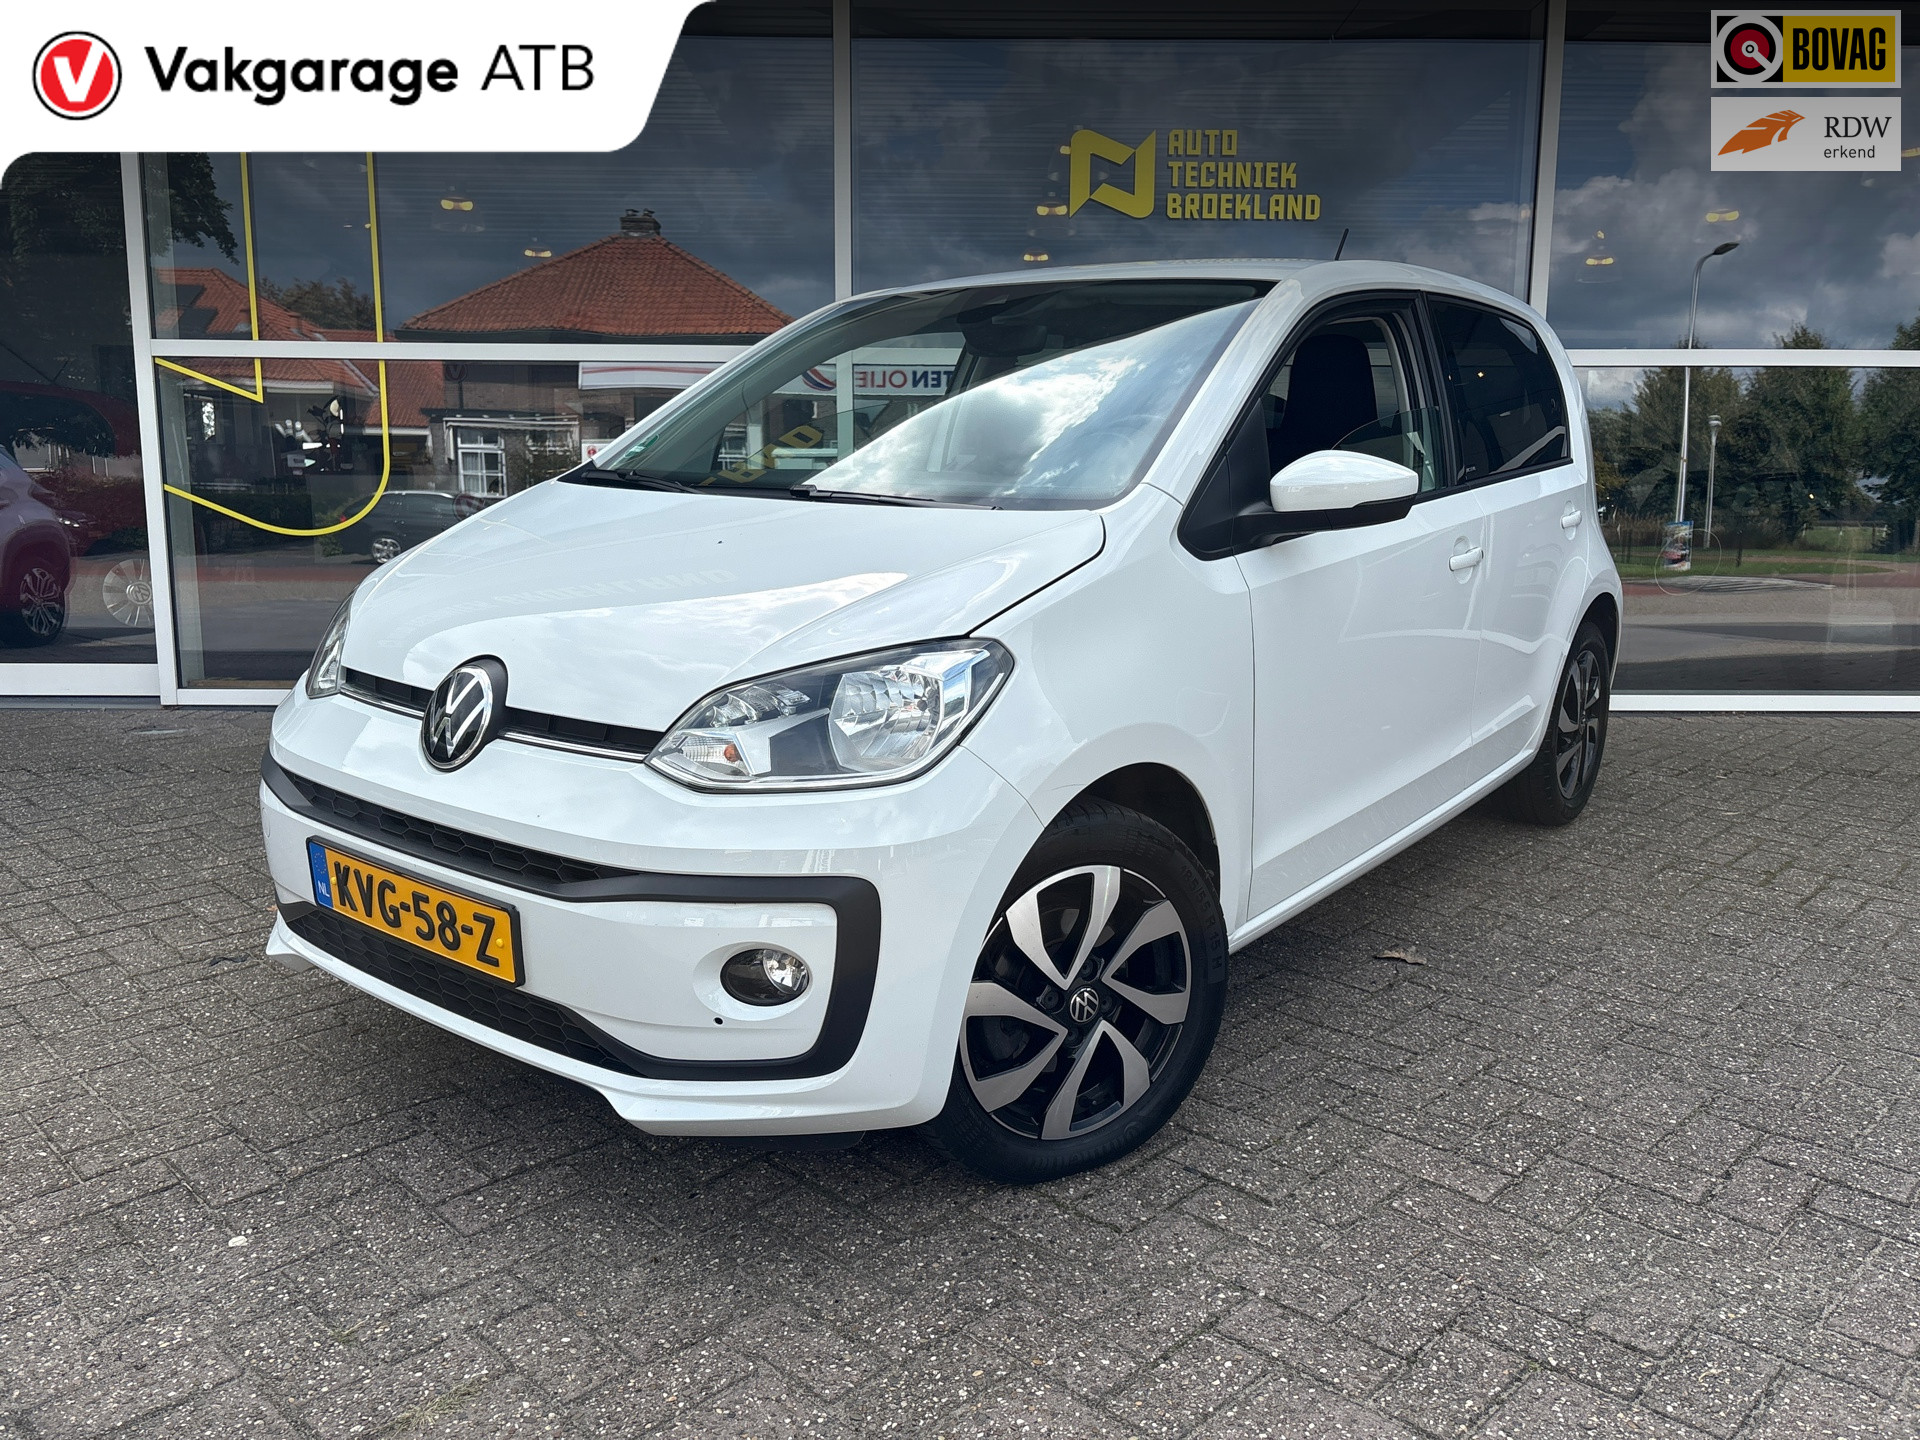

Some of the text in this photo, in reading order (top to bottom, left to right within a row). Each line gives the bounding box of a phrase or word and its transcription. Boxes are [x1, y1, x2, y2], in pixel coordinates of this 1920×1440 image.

[1168, 129, 1238, 156] AUTO
[1167, 161, 1297, 188] TECHNIEK
[1166, 193, 1321, 221] BROEKLAND
[317, 880, 330, 897] NL
[333, 860, 500, 968] KVG-58-Z
